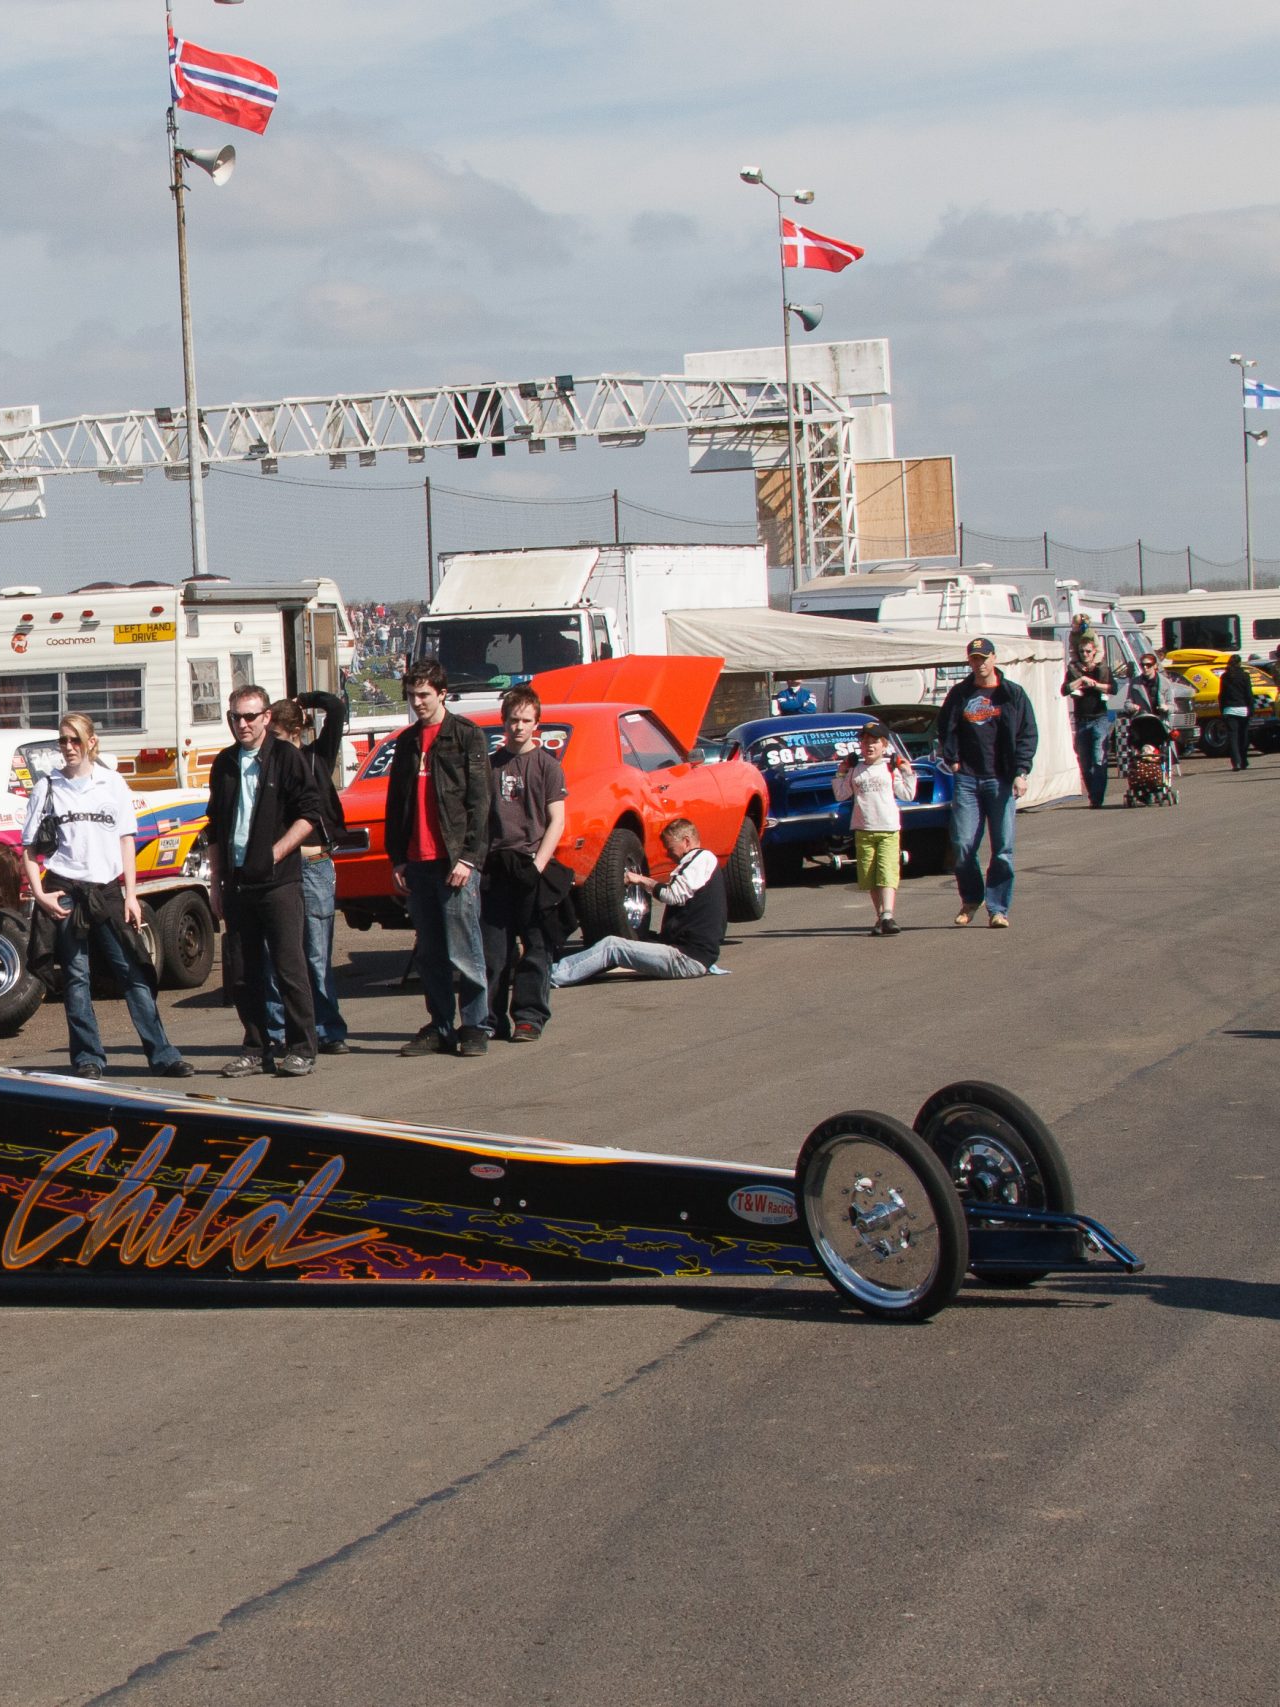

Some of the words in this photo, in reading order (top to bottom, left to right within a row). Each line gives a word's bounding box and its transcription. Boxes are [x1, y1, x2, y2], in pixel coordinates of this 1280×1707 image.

[118, 623, 142, 634] LEFT
[147, 621, 171, 632] HAND
[46, 637, 96, 646] Coachmen
[131, 631, 157, 642] DRIVE
[2, 1121, 389, 1270] Child
[737, 1192, 767, 1212] T&W
[768, 1201, 793, 1217] Racing
